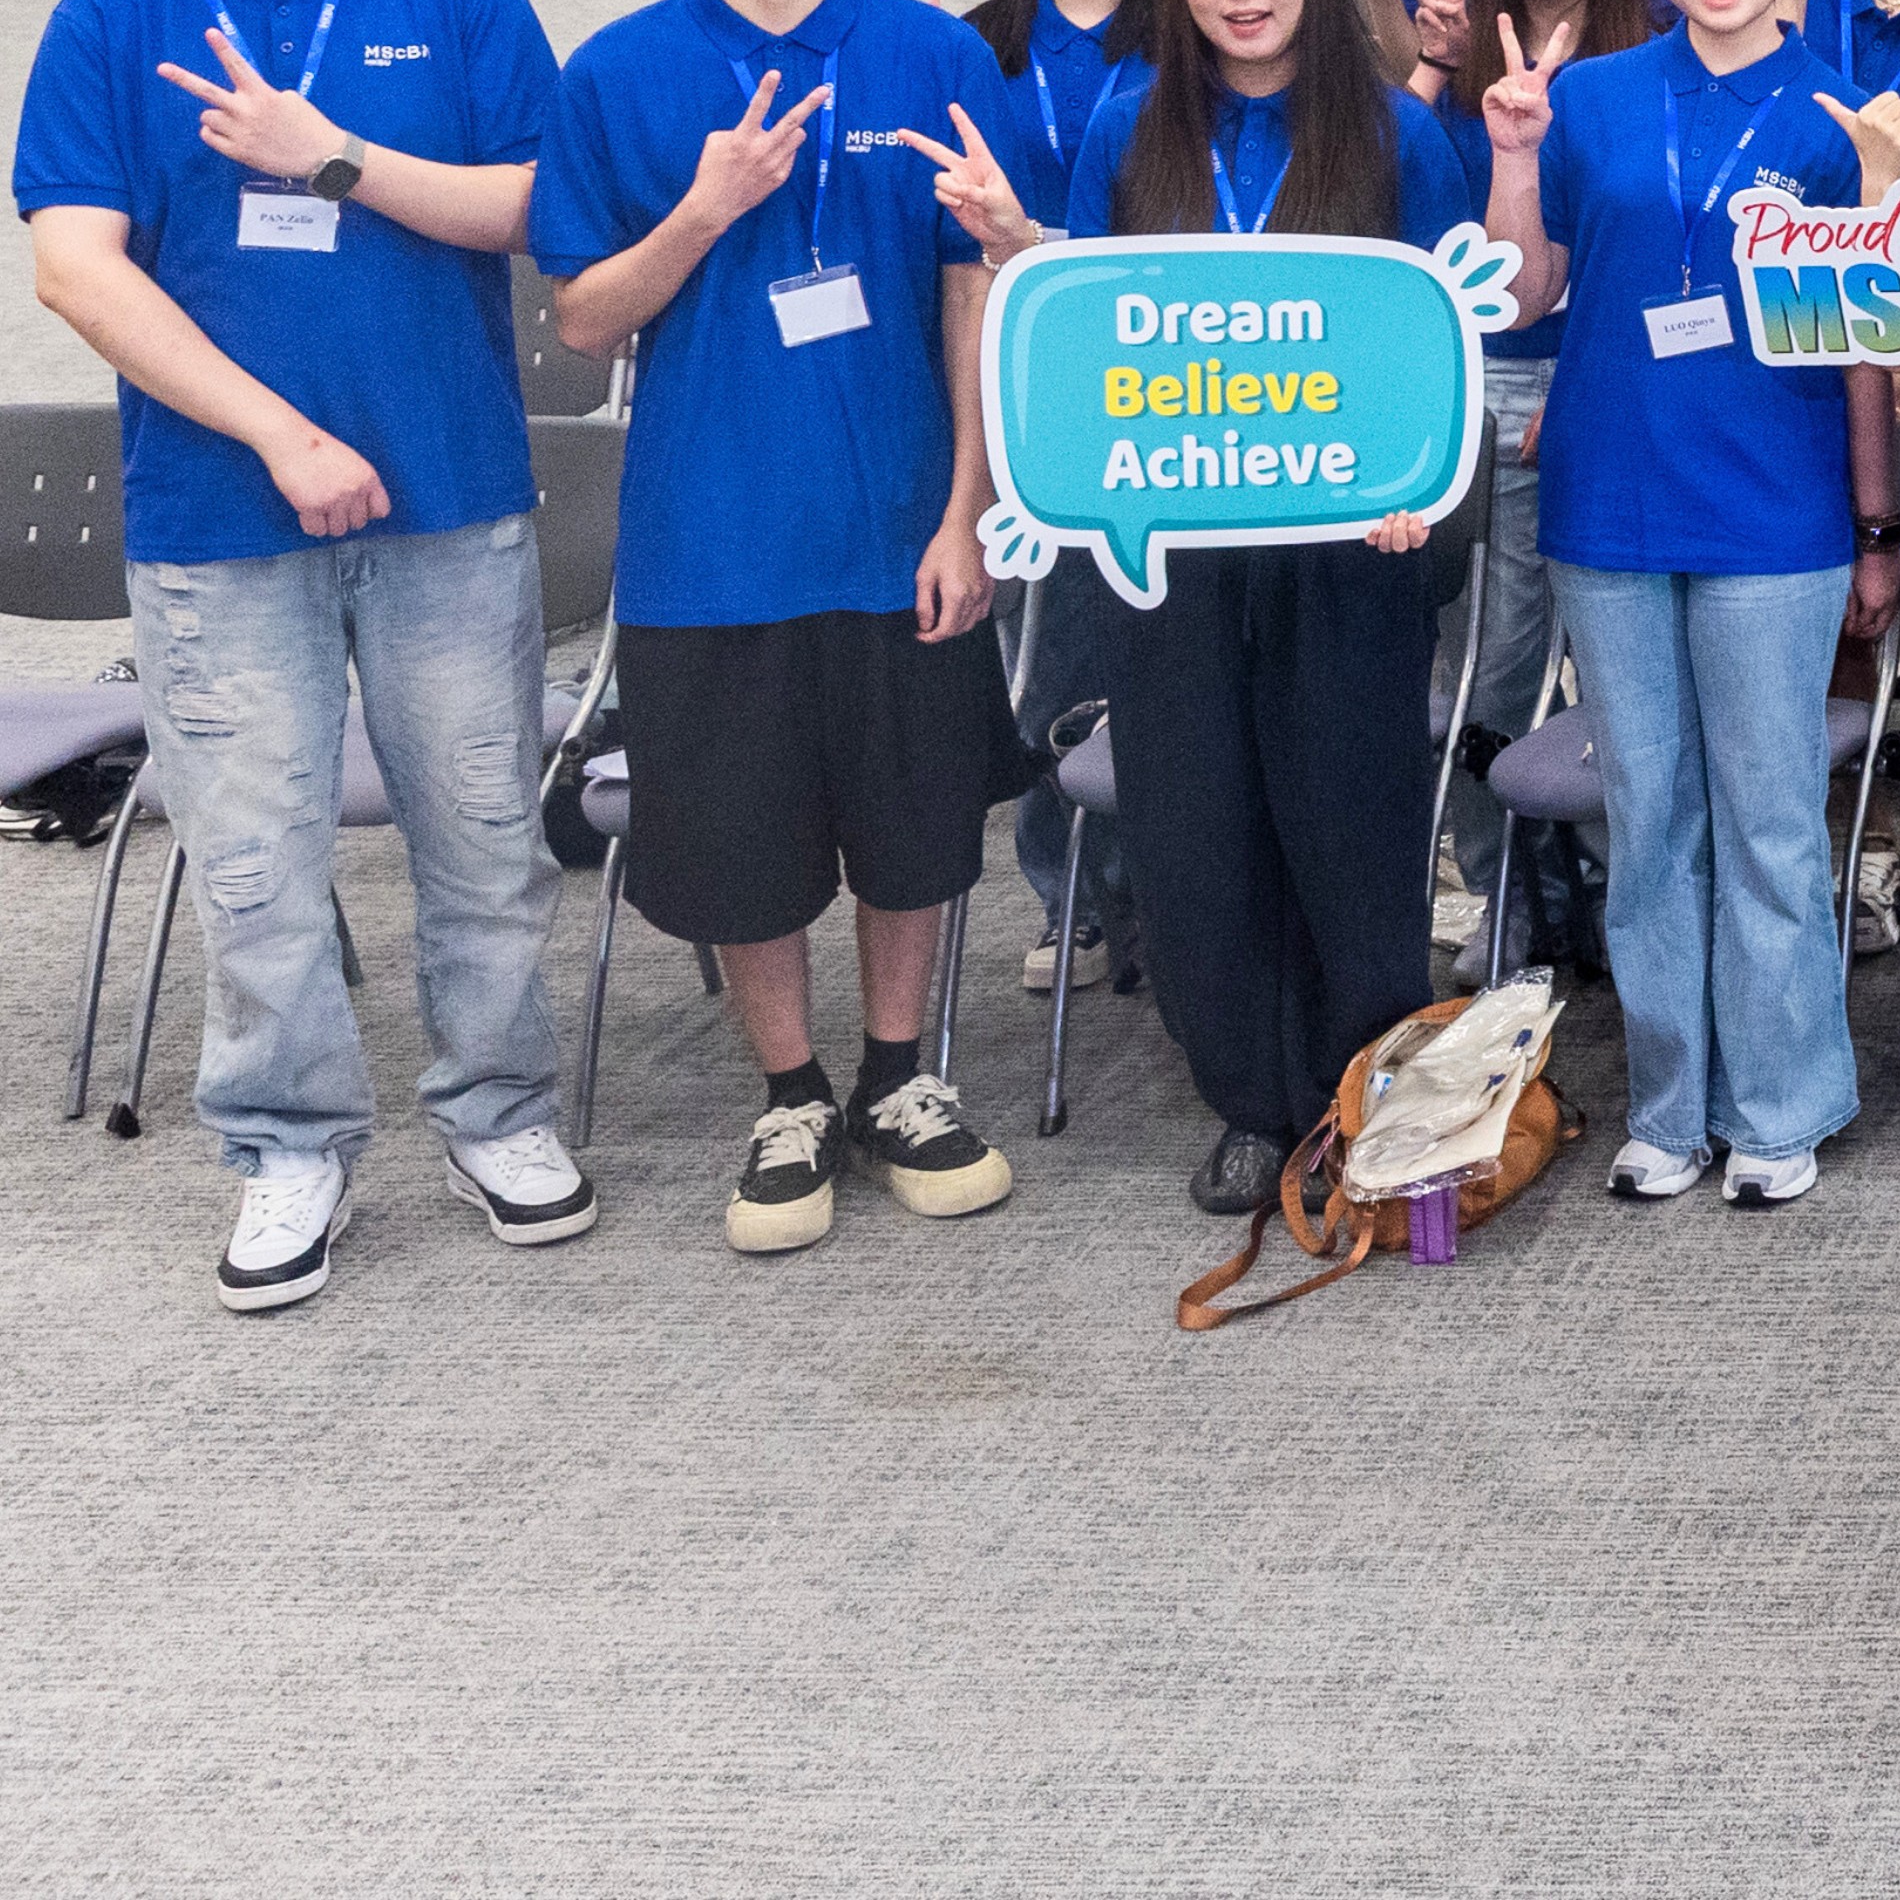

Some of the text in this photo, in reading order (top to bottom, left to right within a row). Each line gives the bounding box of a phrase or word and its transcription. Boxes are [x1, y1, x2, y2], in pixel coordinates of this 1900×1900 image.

[317, 3, 336, 30] HKBU
[1737, 128, 1755, 150] HKBU
[819, 159, 829, 188] HKBU
[1703, 185, 1721, 213] HKBU
[1115, 293, 1325, 346] Dream
[1664, 322, 1687, 334] LUO
[1104, 357, 1340, 418] Believe
[1102, 428, 1357, 491] Achieve
